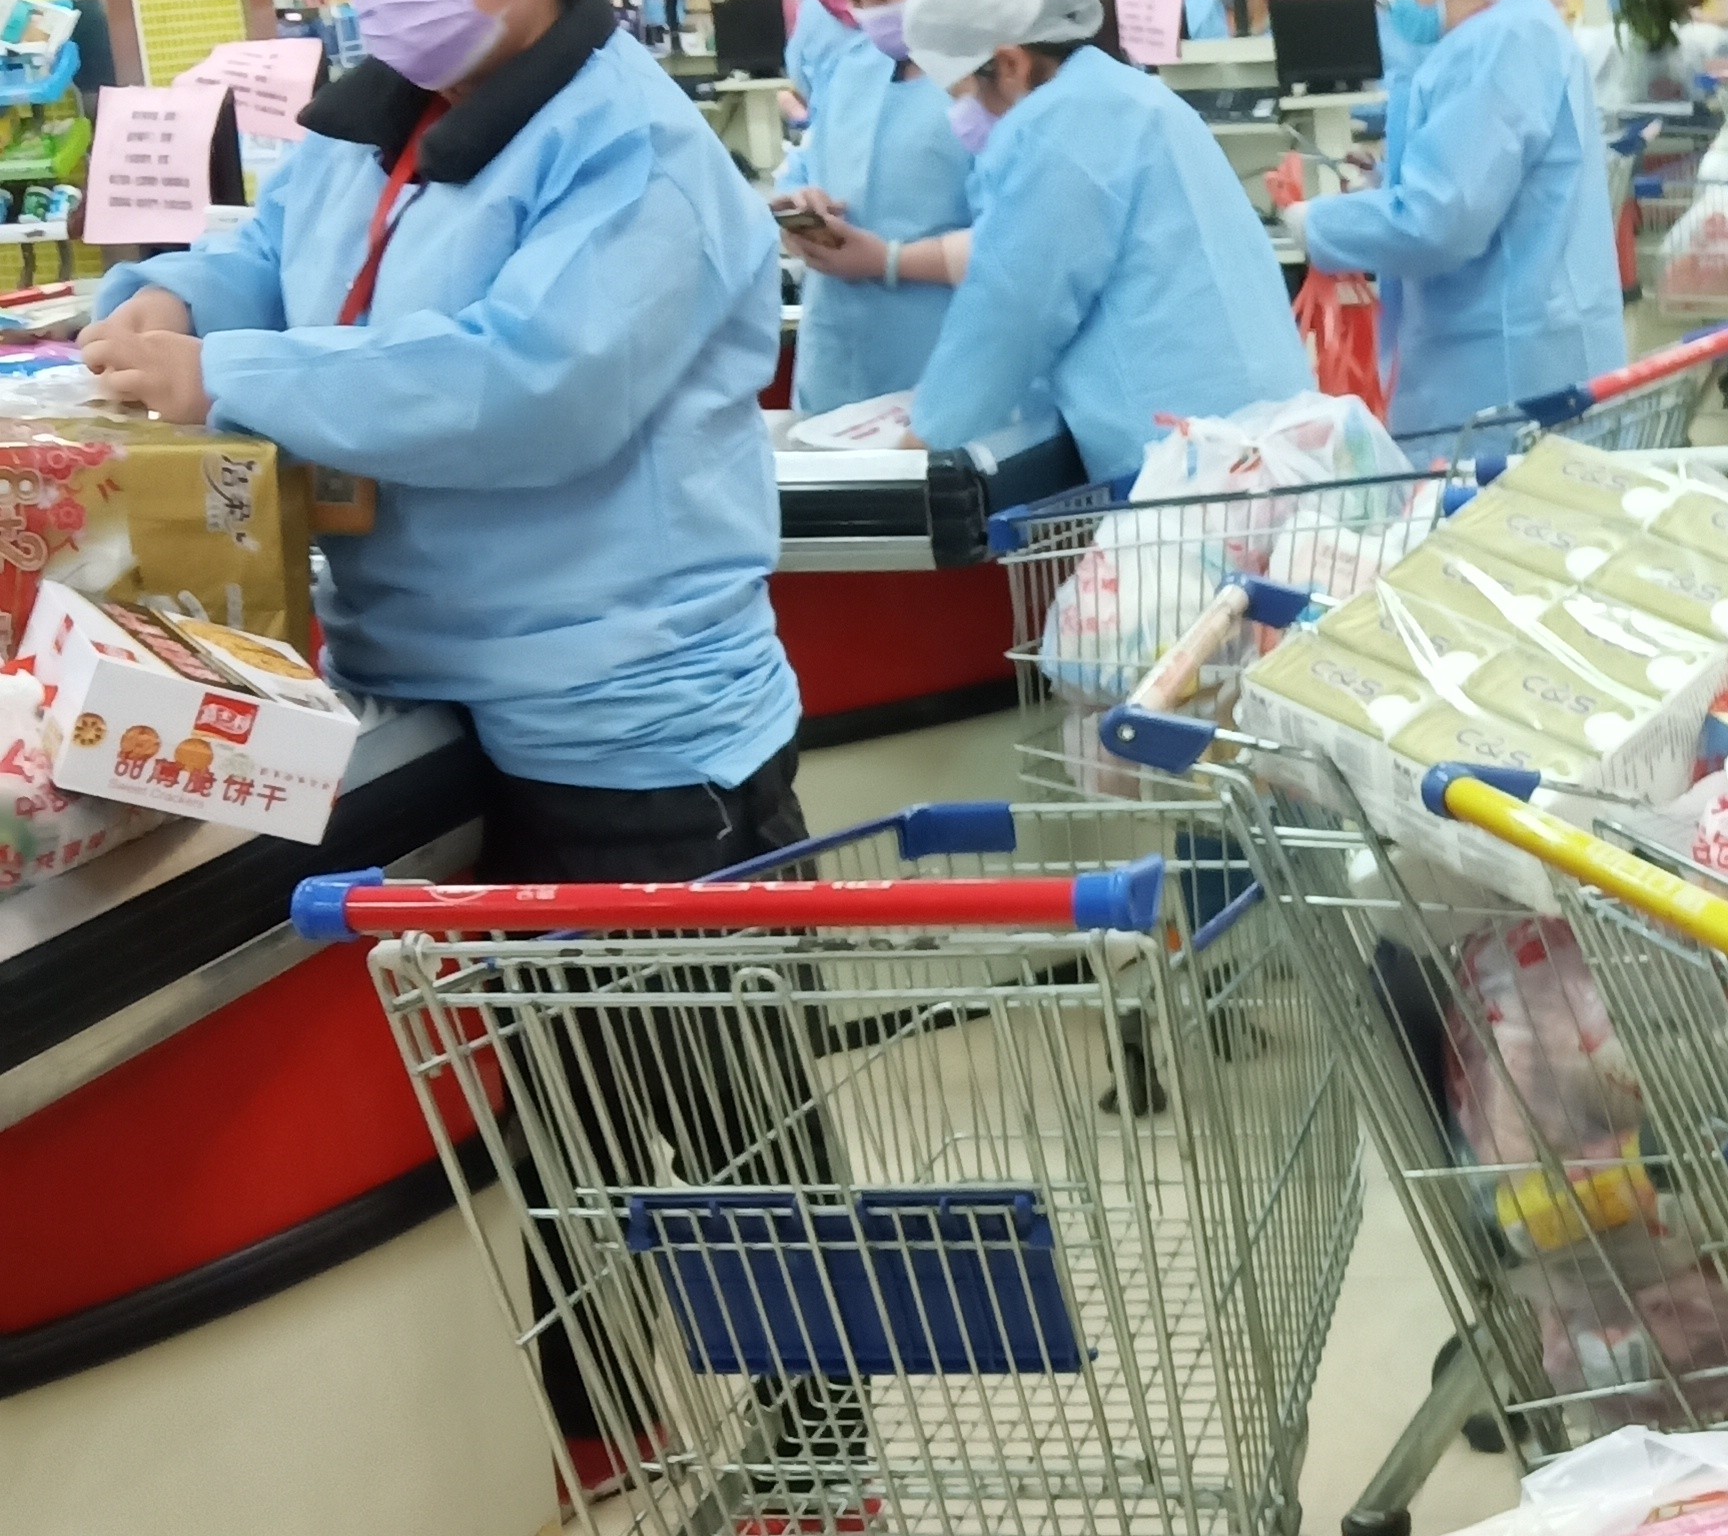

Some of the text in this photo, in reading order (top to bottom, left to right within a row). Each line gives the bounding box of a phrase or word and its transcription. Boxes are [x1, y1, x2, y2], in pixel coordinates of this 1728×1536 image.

[1522, 674, 1597, 714] C&S
[1456, 727, 1533, 769] C&S
[113, 750, 288, 813] 甜薄脆饼干
